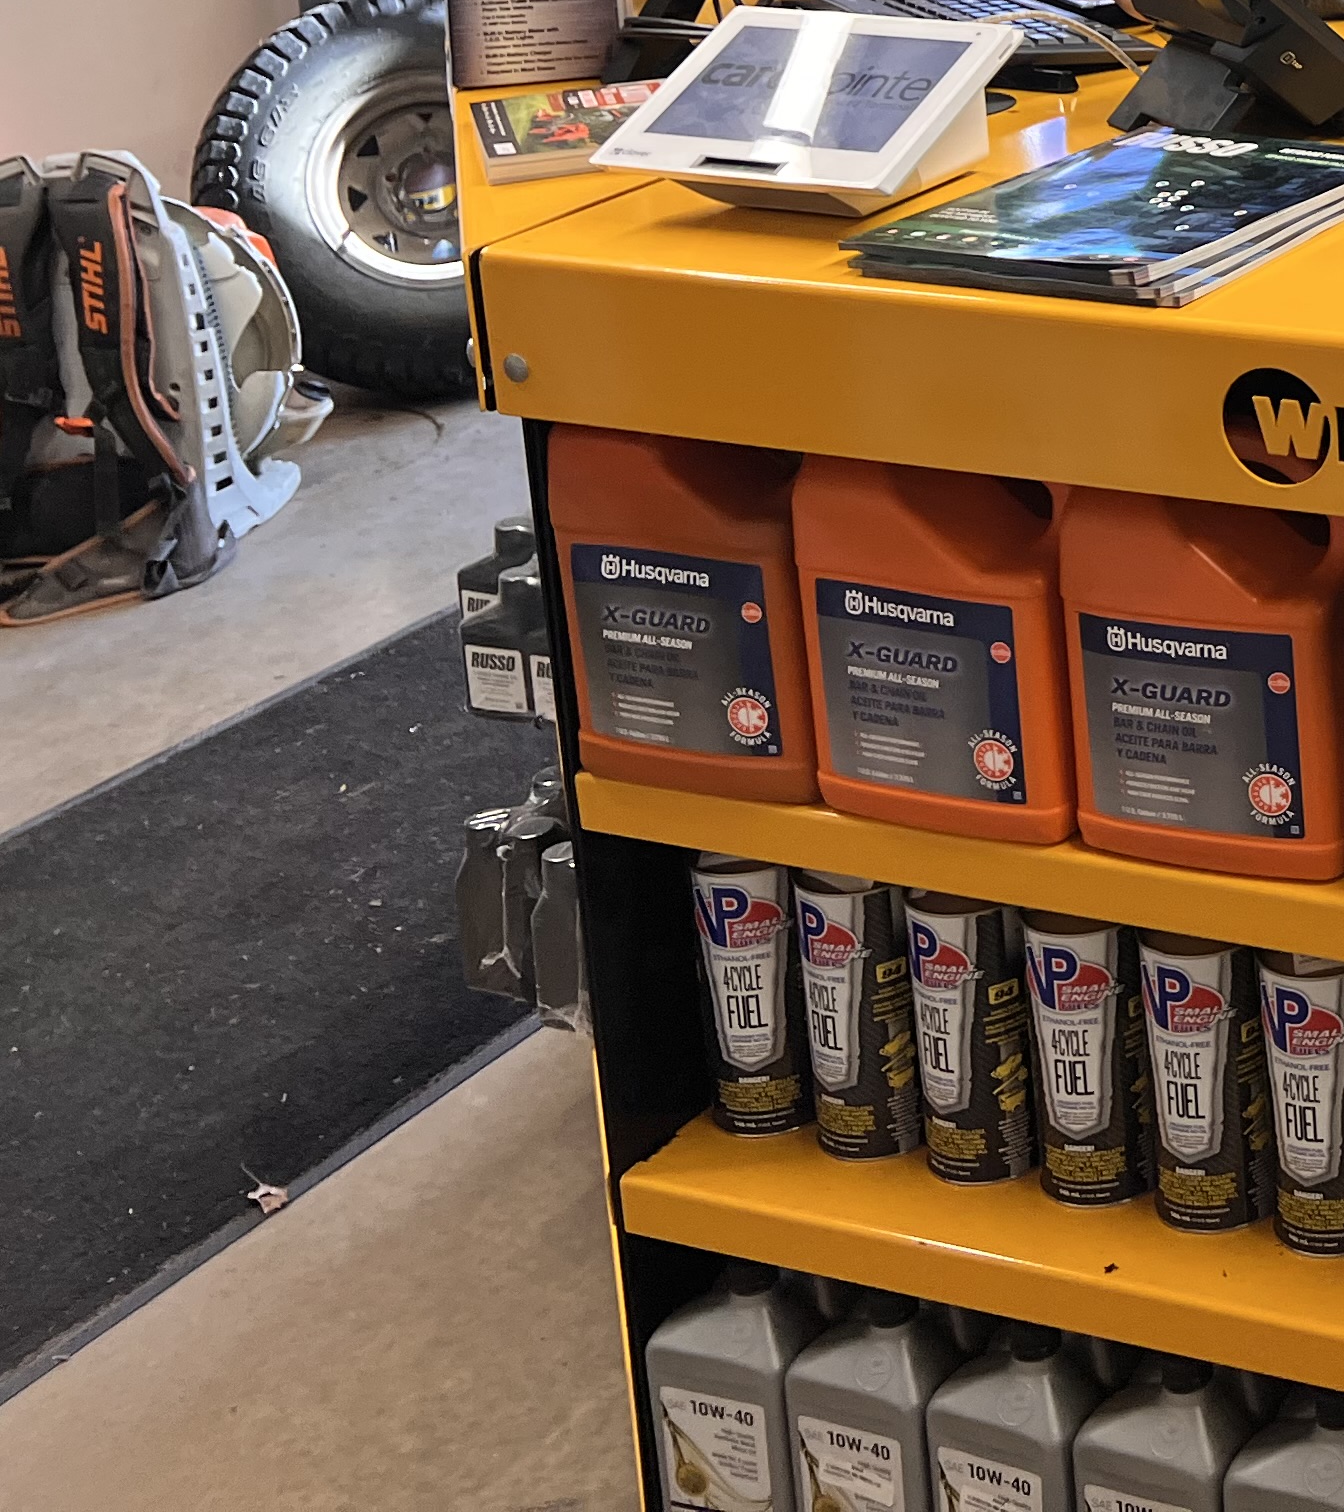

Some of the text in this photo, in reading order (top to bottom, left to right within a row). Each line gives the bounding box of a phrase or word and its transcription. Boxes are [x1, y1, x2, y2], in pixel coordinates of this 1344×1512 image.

[80, 240, 109, 335] STIHL
[622, 559, 710, 588] Husqvarna
[602, 604, 711, 634] X-GUARD
[864, 595, 954, 627] Husqvarna
[847, 640, 958, 673] X-GUARD
[1127, 631, 1228, 661] Husqvarna
[471, 651, 516, 672] RUSSO
[1111, 677, 1232, 708] X-GUARD
[1111, 702, 1211, 724] PREMIUM ALL-SEASON
[1114, 717, 1134, 729] BAR
[1146, 721, 1180, 736] CHAIN
[1241, 762, 1297, 787] ALL-SEASON
[1249, 808, 1295, 826] FORMULA
[694, 886, 750, 949] VP
[723, 963, 764, 992] 4-CYCLE
[1026, 943, 1080, 1011] VP
[726, 994, 769, 1030] FUEL
[1051, 1029, 1091, 1057] 4-CYCLE
[1055, 1060, 1095, 1096] FUEL
[689, 1398, 755, 1428] 10W-40
[826, 1430, 892, 1462] 10W-40
